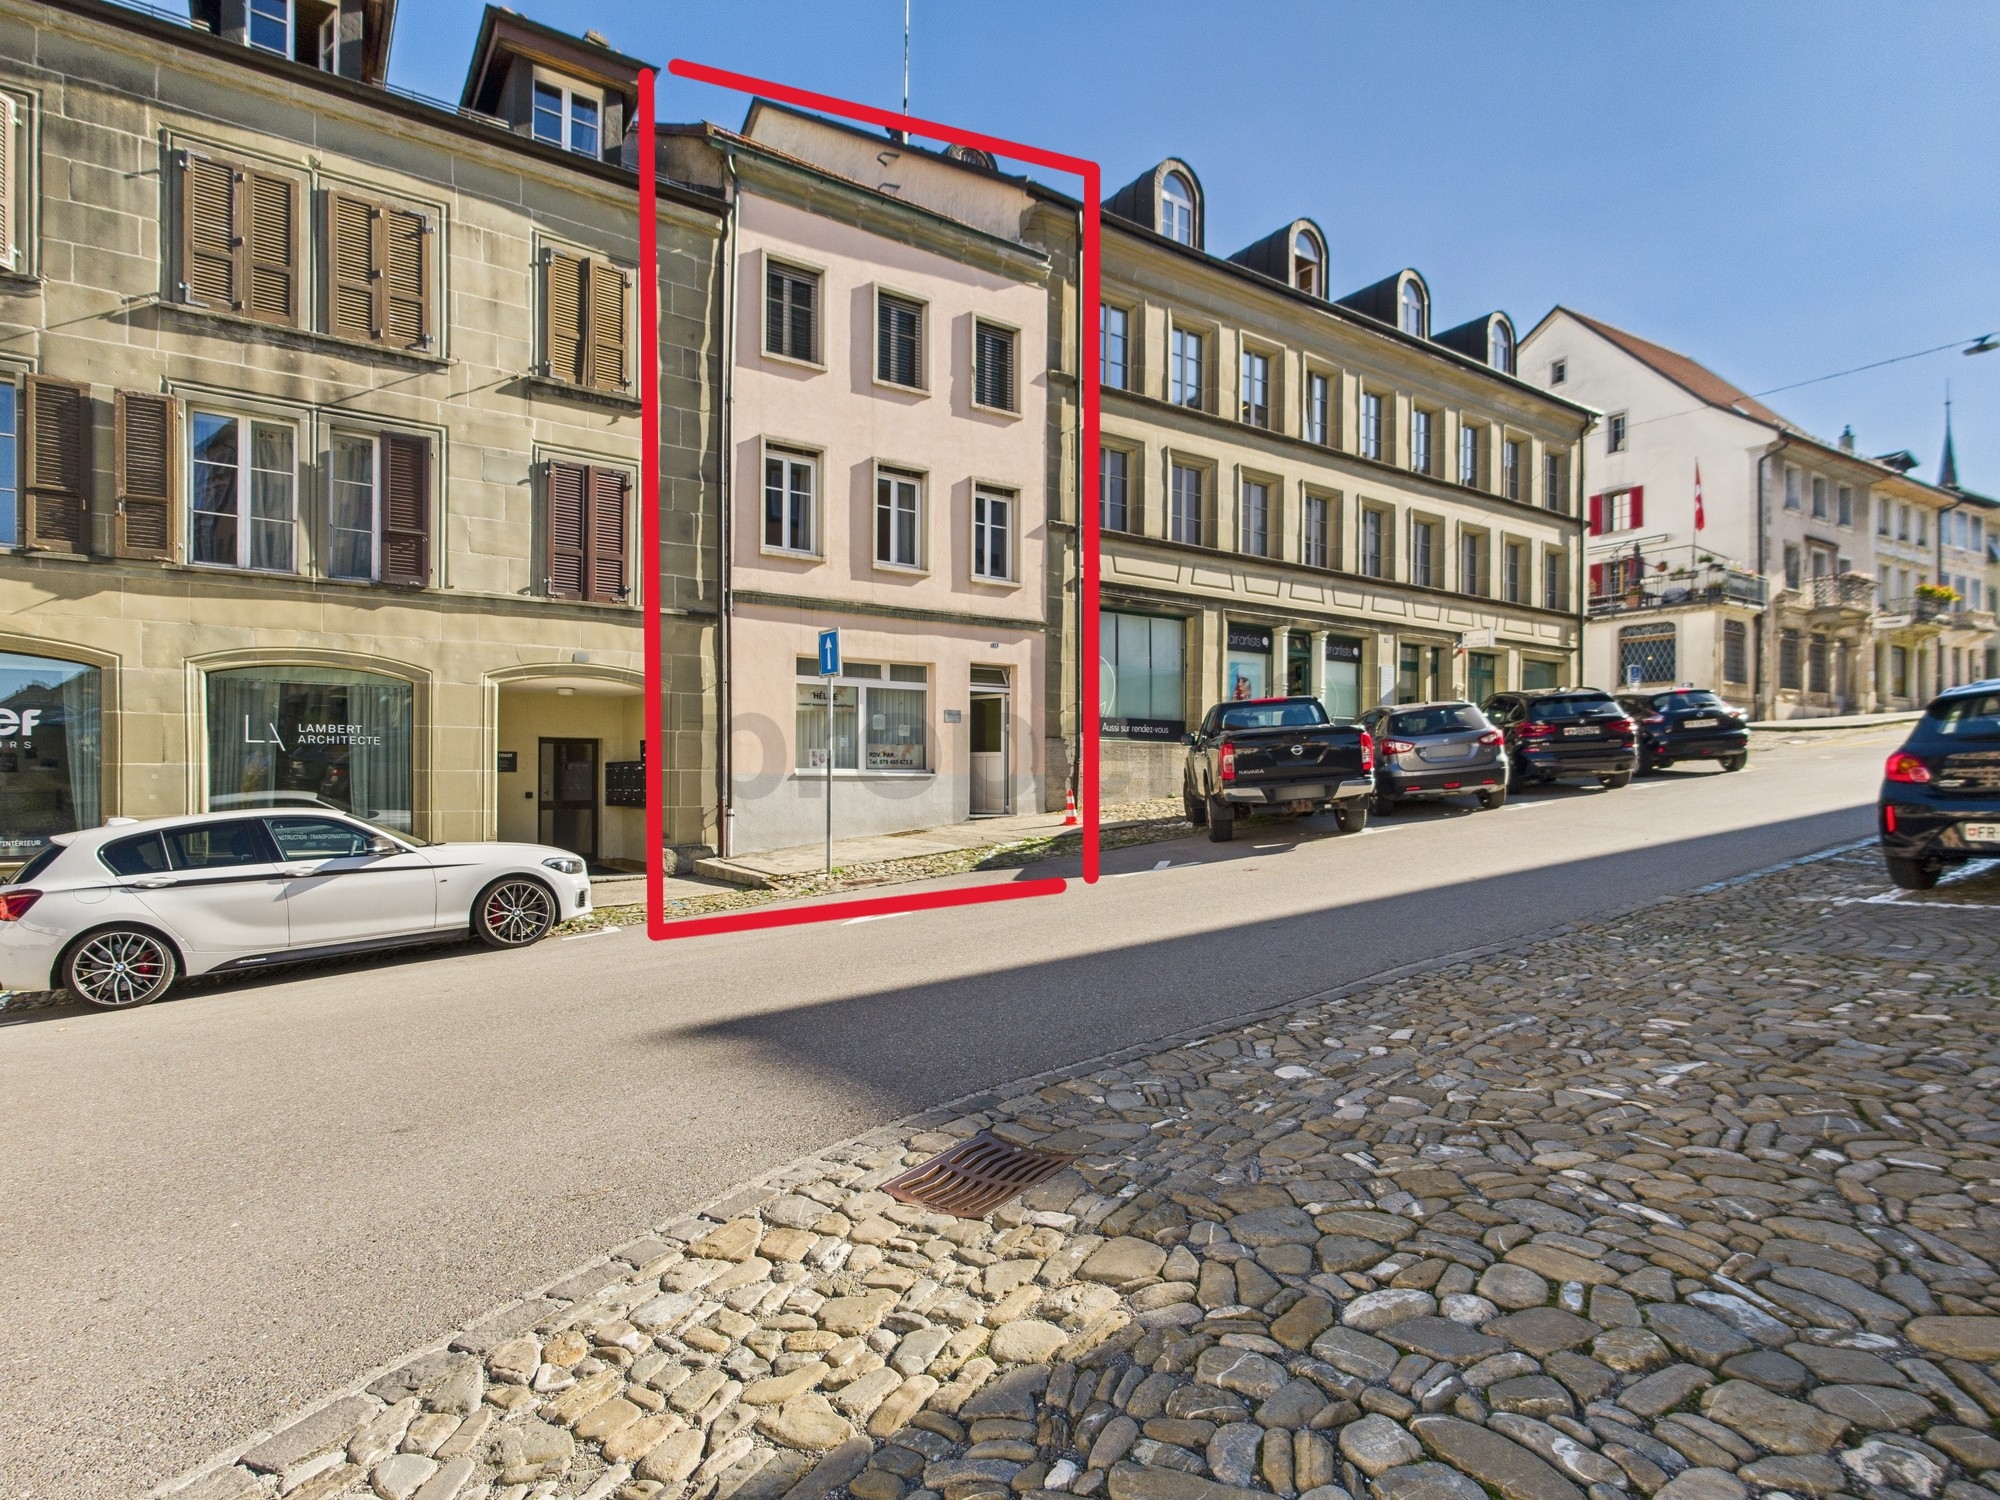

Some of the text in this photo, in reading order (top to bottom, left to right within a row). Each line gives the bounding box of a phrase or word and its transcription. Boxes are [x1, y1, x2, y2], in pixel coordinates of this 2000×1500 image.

[298, 723, 363, 734] LAMBERT
[1102, 722, 1120, 732] Aussi
[1121, 725, 1131, 733] sur
[297, 735, 382, 746] ARCHITECTE
